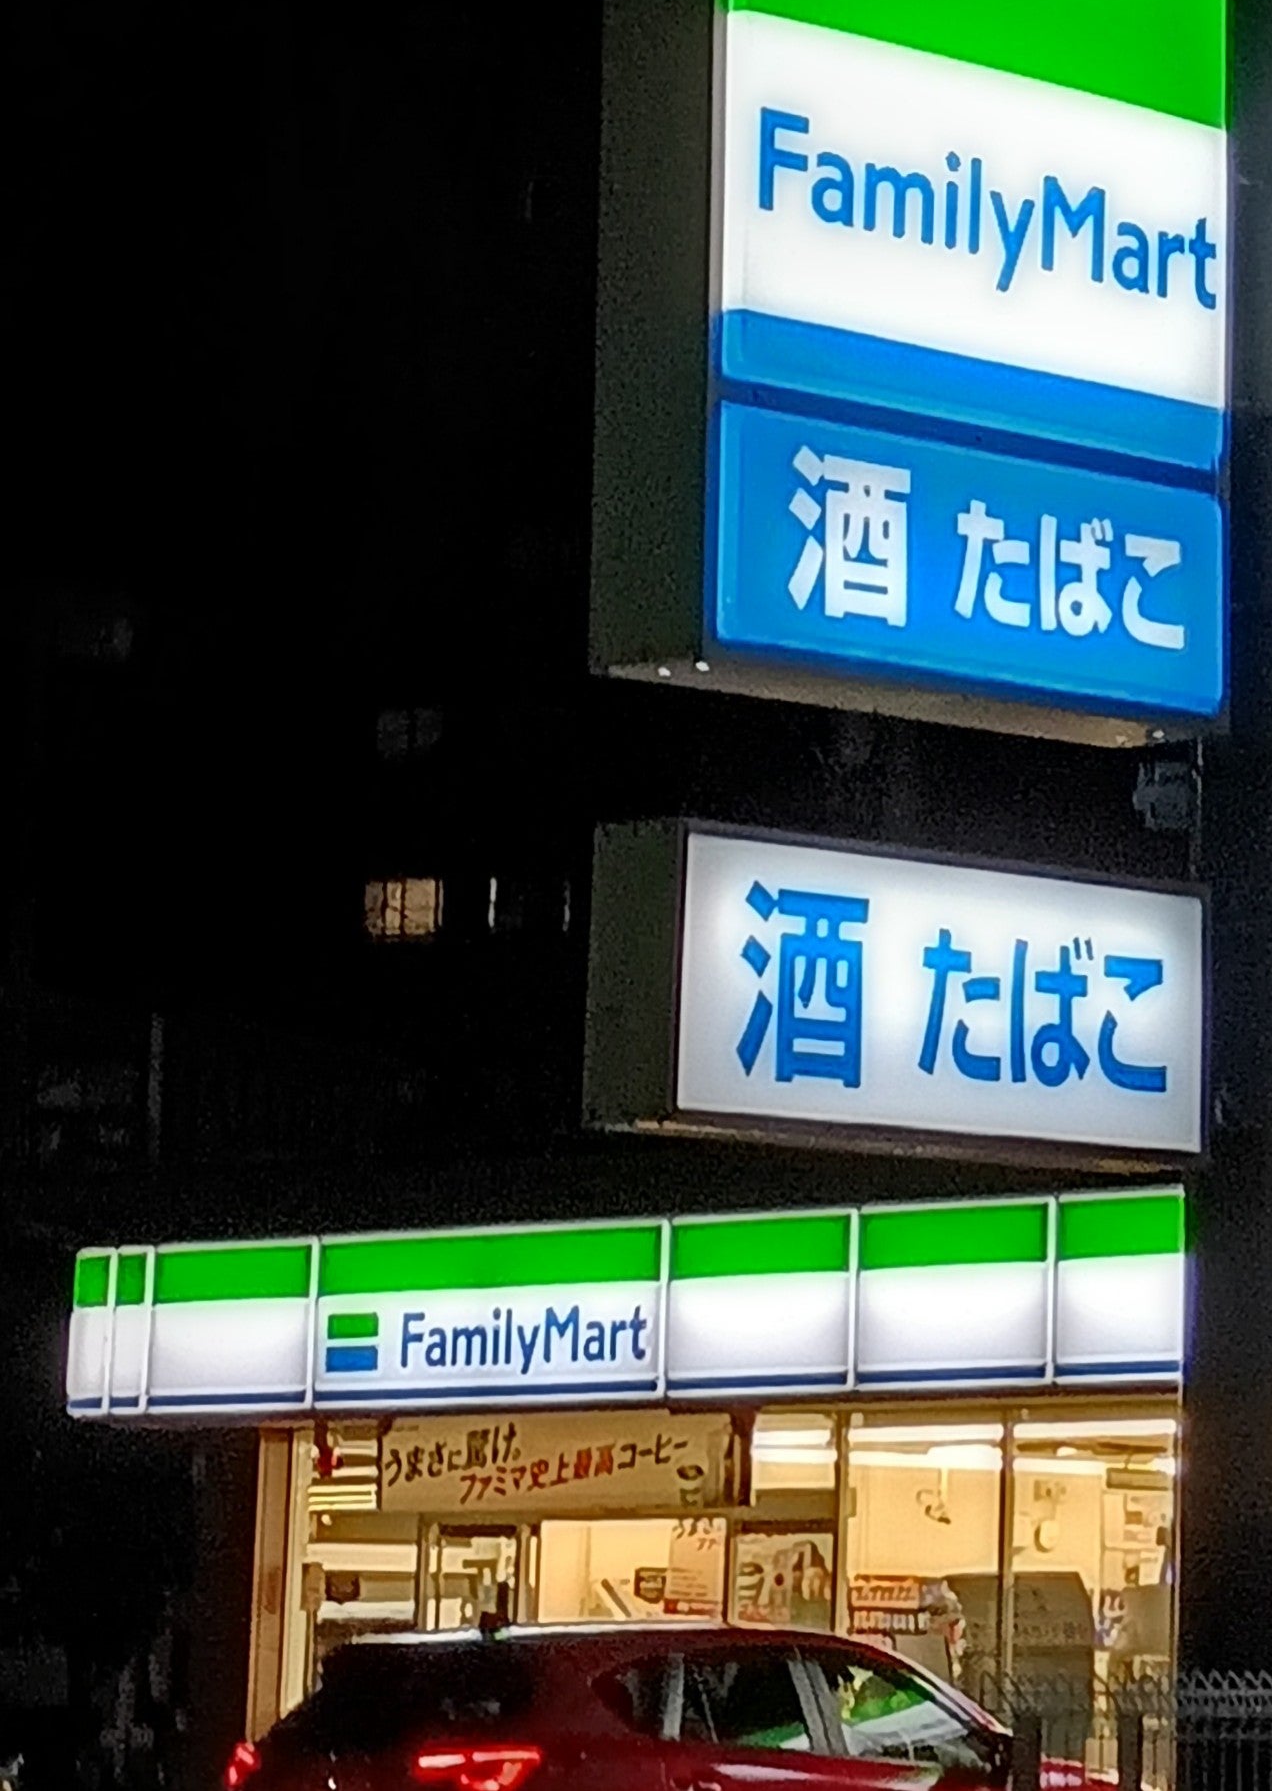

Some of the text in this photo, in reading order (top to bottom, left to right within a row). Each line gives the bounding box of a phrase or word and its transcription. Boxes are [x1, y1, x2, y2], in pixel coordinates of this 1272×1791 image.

[758, 105, 1218, 309] FamilyMart
[787, 444, 1187, 651] 酒 たばこ
[736, 879, 1168, 1093] 酒 たばこ
[399, 1304, 648, 1375] FamilyMart
